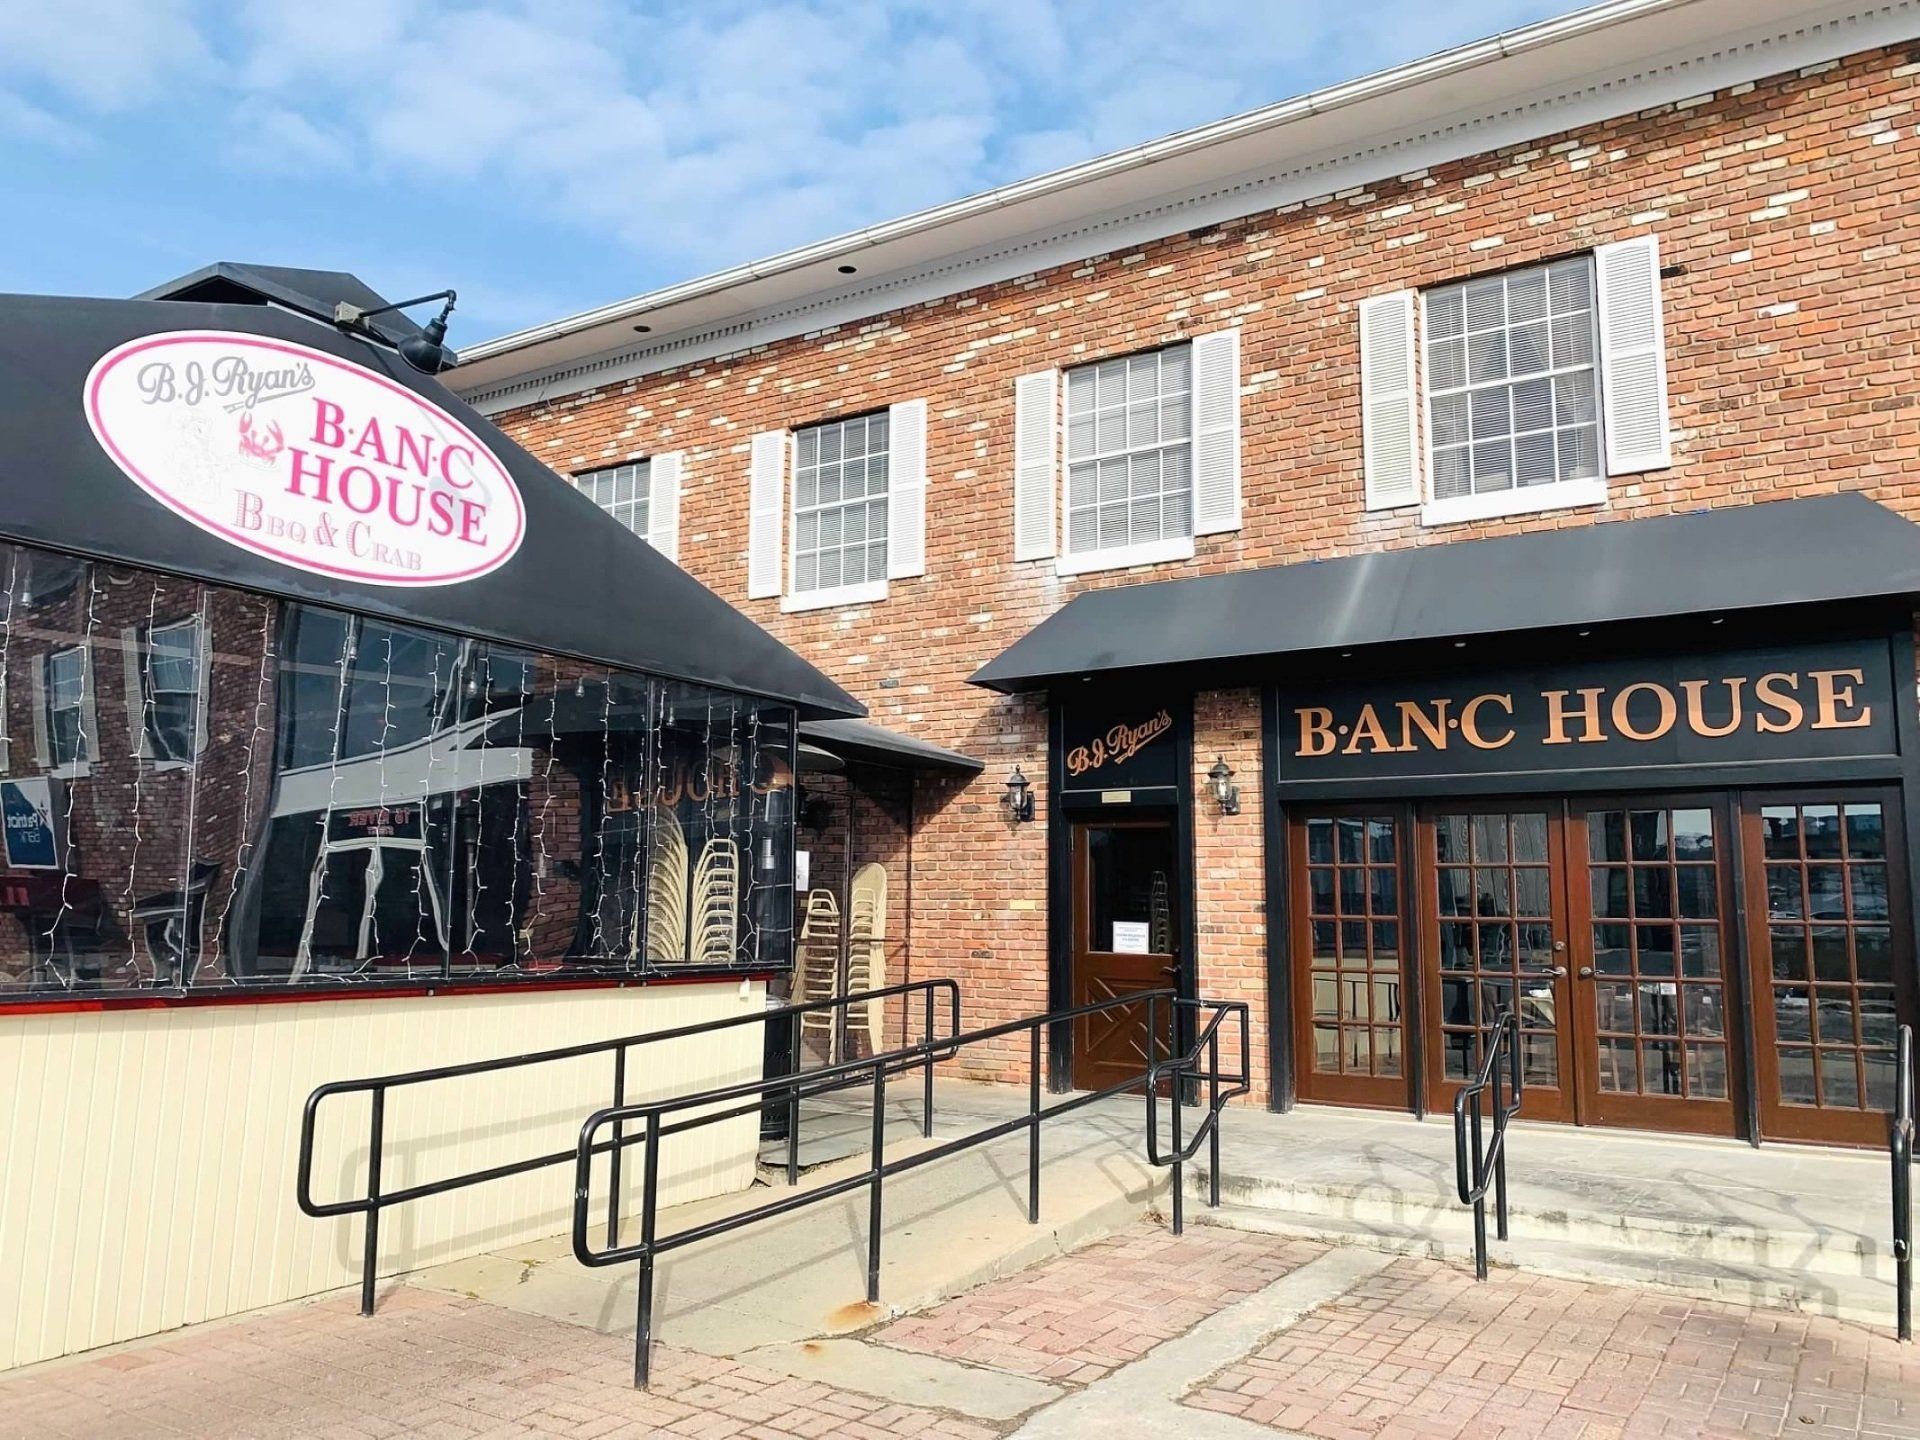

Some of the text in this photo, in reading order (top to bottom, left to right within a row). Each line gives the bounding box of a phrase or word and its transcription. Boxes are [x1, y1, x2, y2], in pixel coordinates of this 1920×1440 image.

[137, 356, 316, 413] B.J. Ryan's
[285, 447, 488, 546] HOUSE
[314, 511, 339, 548] &
[1541, 668, 1871, 745] HOUSE
[1067, 709, 1172, 777] B.J. Ryan's
